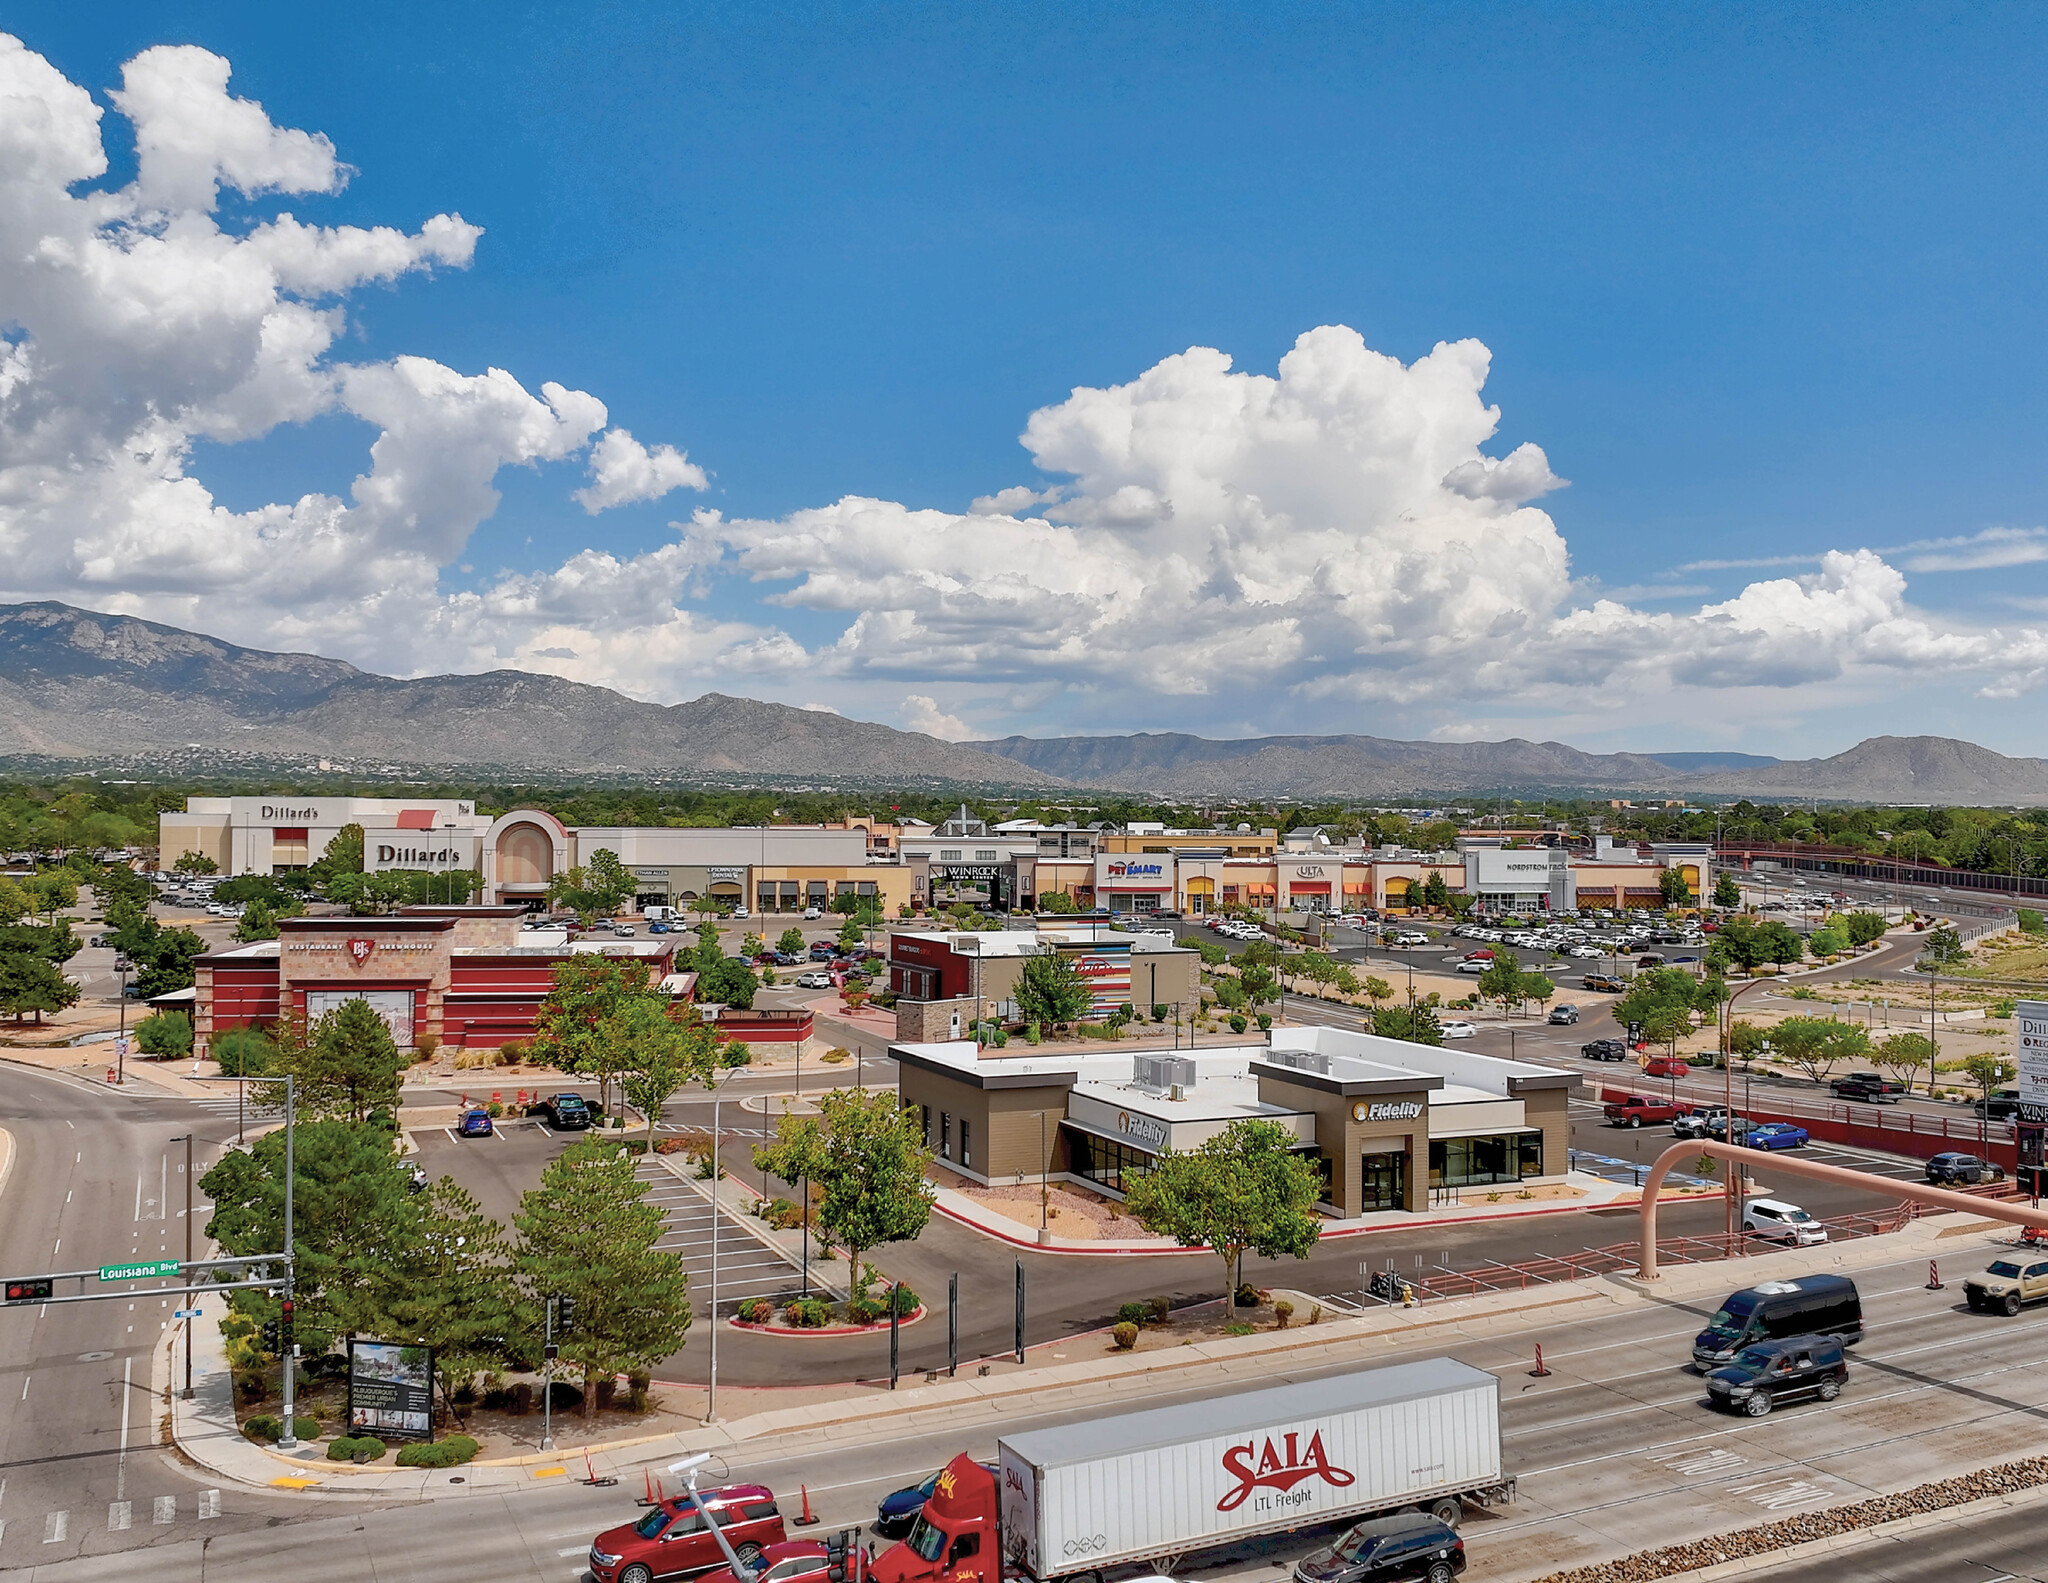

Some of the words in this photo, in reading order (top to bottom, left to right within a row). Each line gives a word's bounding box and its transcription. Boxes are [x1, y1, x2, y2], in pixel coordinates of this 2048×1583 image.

[261, 806, 319, 818] Dillard's
[378, 845, 460, 862] Dillard's
[947, 866, 998, 876] WINROCK
[1299, 865, 1325, 877] ULTA
[1506, 863, 1548, 871] NORDSTROM
[1549, 862, 1567, 871] rack
[353, 941, 369, 958] BJ's
[1368, 1101, 1424, 1119] Fidelity
[1128, 1117, 1167, 1146] Fidelity
[100, 1266, 156, 1280] Louisiana
[160, 1262, 178, 1271] Blvd
[353, 1400, 387, 1408] COMMUNITY
[1216, 1428, 1356, 1512] SAIA
[1411, 1463, 1445, 1474] www.saia.com
[1255, 1497, 1272, 1512] LTL
[1275, 1489, 1313, 1507] Freight
